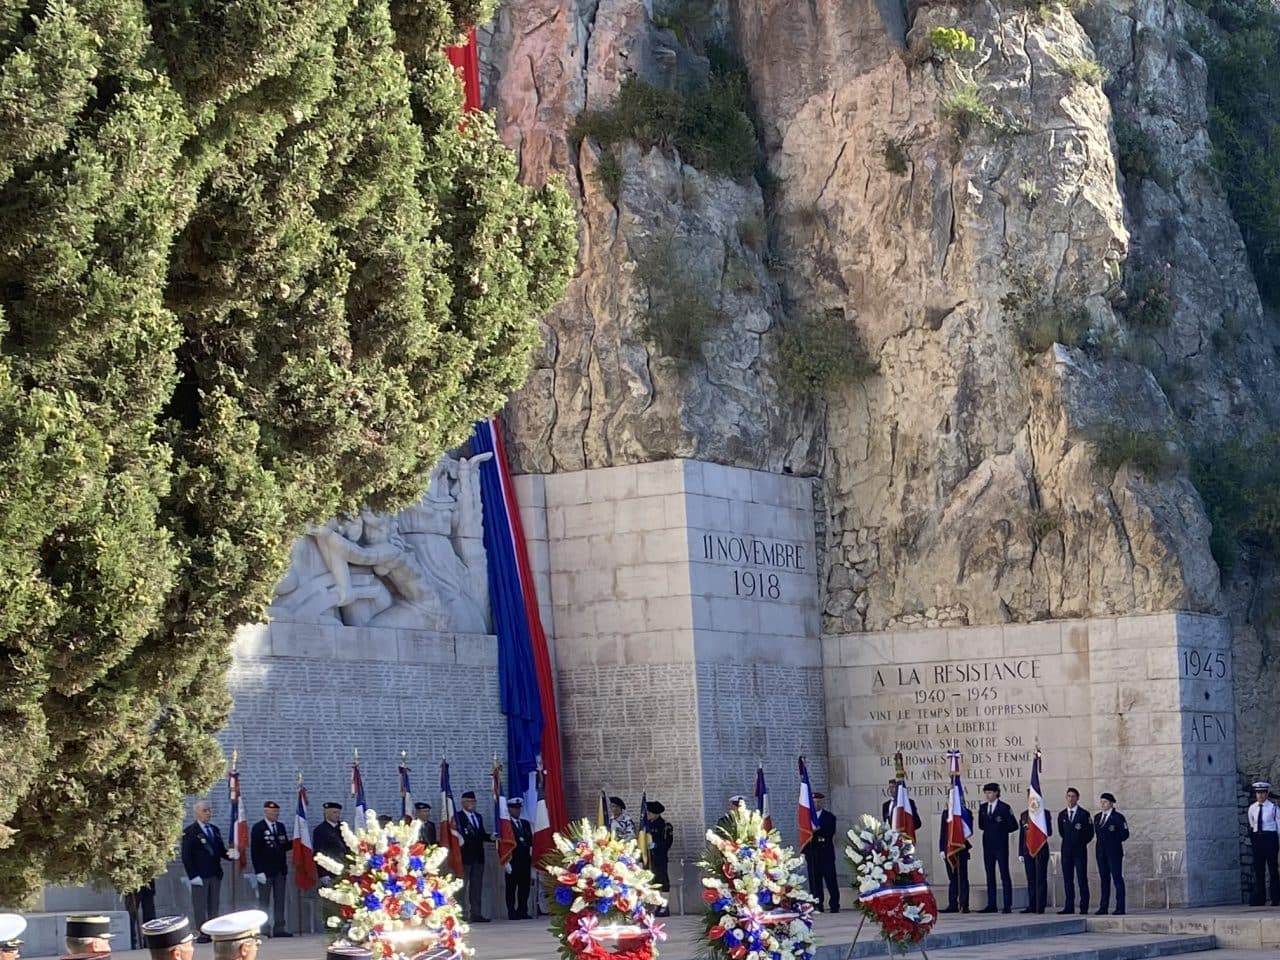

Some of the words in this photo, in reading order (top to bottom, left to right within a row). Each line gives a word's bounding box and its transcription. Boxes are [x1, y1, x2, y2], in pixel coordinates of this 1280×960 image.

[717, 536, 805, 570] NOVEMBRE
[734, 570, 780, 600] 1918
[872, 669, 885, 687] A
[898, 667, 921, 686] LA
[934, 659, 1041, 684] RESISTANCE
[1183, 650, 1226, 679] 1945
[915, 689, 946, 704] 1940
[967, 686, 998, 702] 1945
[869, 710, 892, 721] VINT
[898, 709, 911, 721] LE
[918, 707, 951, 720] TEMPS
[956, 706, 969, 718] DE
[917, 724, 930, 735] ET
[936, 723, 951, 734] LA
[1190, 714, 1227, 742] AFN
[966, 737, 998, 749] NOTRE
[1004, 735, 1025, 747] SOL
[905, 754, 947, 767] HOMMES
[972, 752, 992, 764] DES
[997, 751, 1032, 763] FEMME
[921, 769, 944, 781] AFIN
[999, 767, 1024, 779] VIVE
